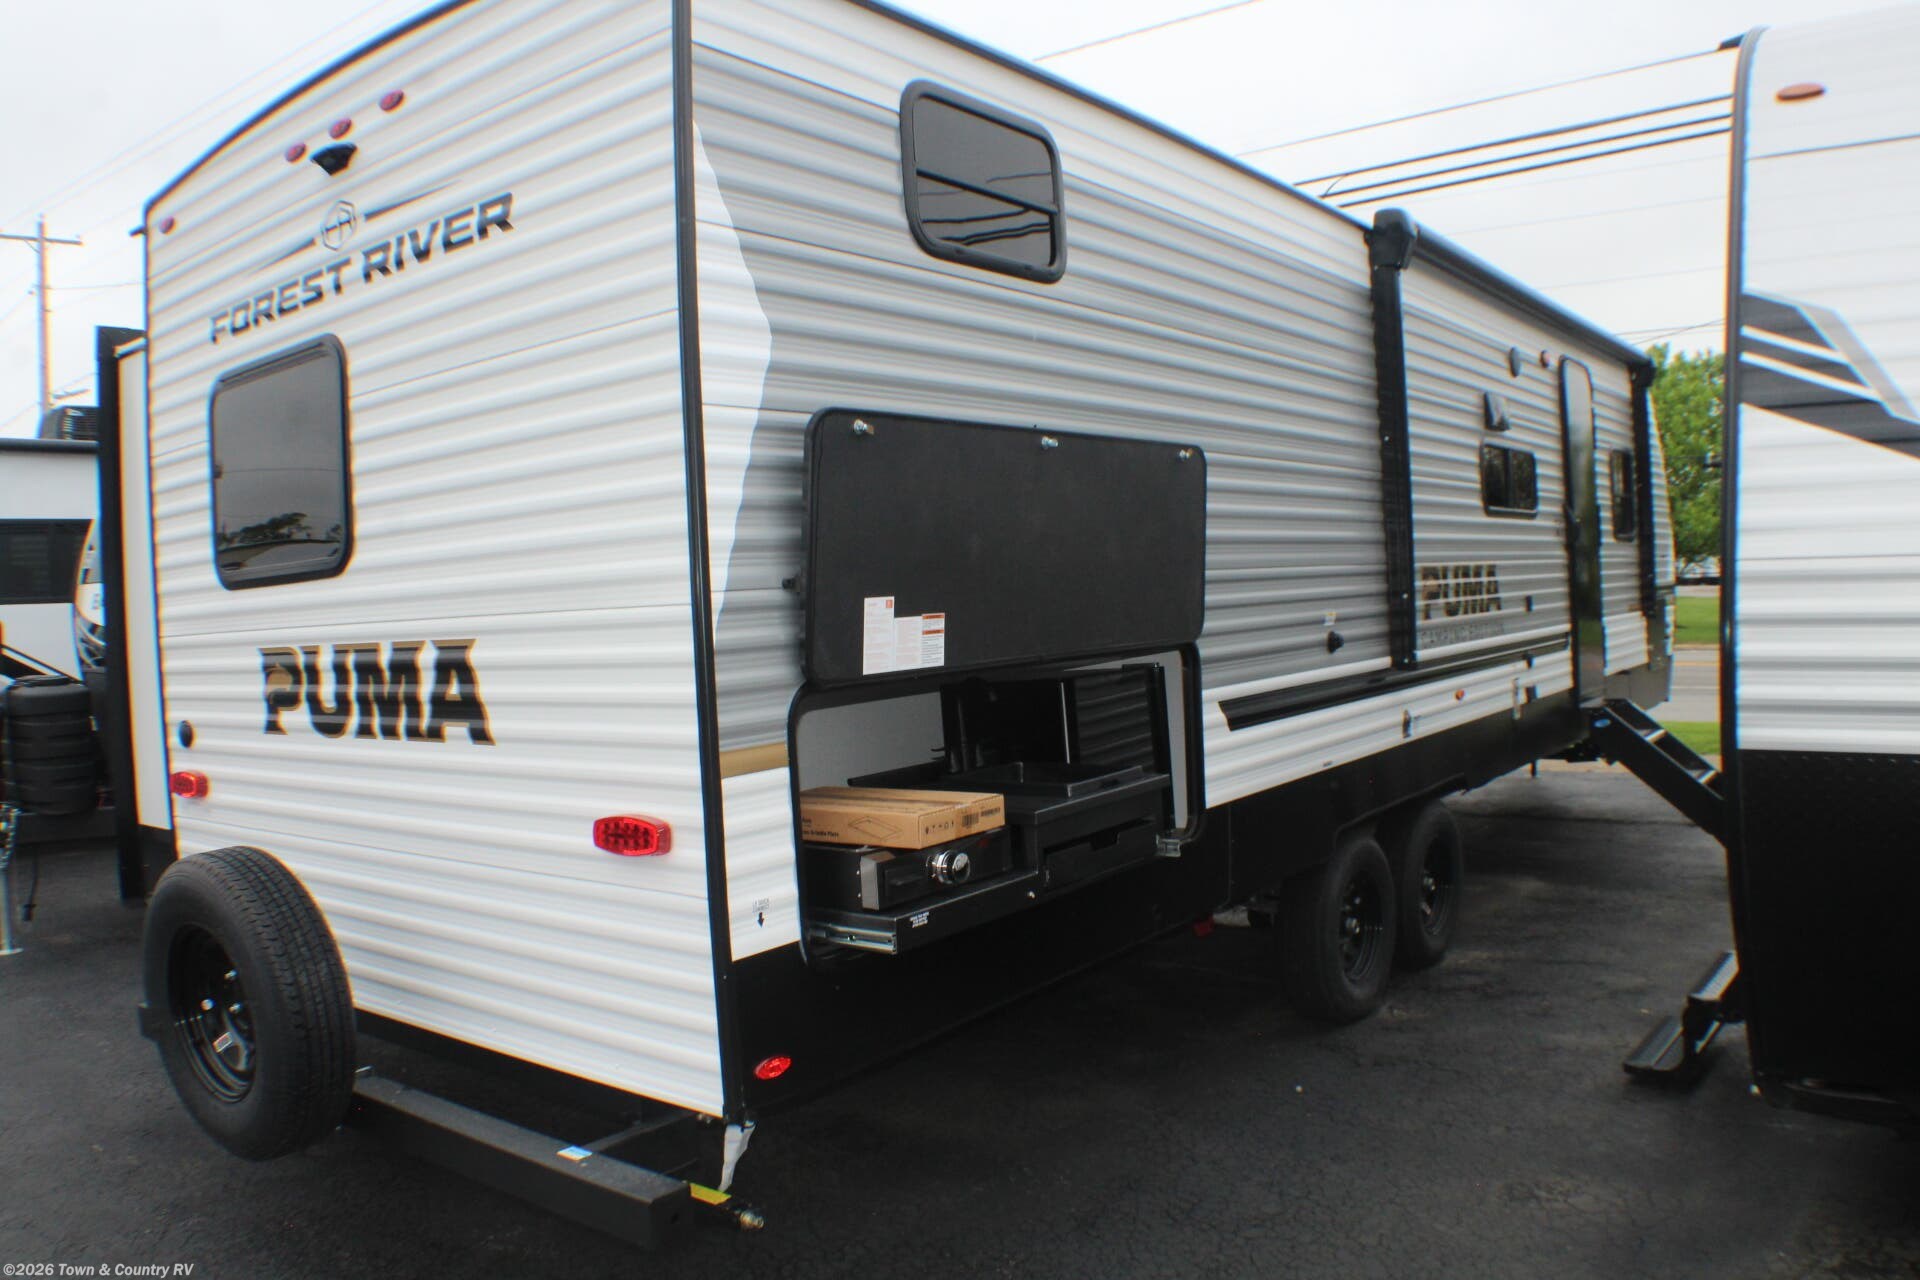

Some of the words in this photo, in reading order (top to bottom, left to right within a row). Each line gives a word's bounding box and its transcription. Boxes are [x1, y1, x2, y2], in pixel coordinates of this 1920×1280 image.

[209, 256, 351, 344] FOREST
[361, 191, 514, 283] RIVER
[1420, 564, 1502, 621] PUMA
[257, 638, 496, 746] PUMA
